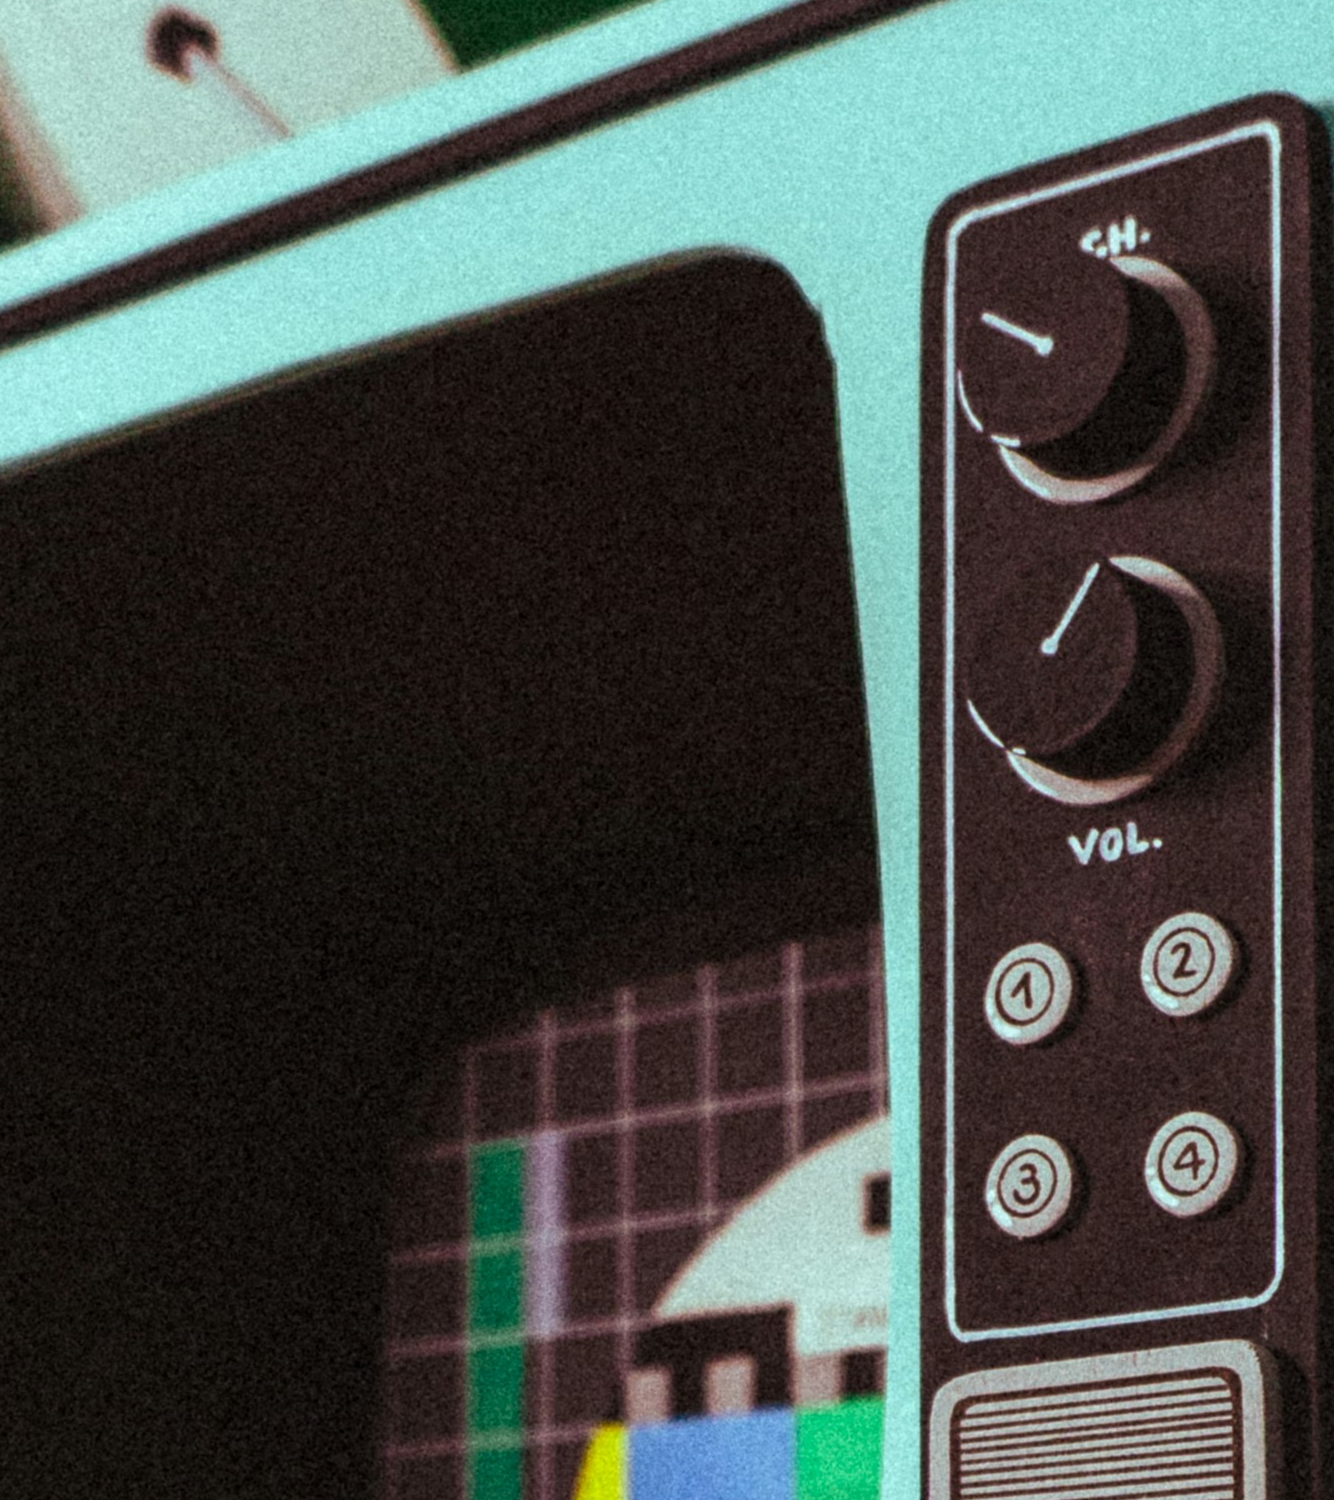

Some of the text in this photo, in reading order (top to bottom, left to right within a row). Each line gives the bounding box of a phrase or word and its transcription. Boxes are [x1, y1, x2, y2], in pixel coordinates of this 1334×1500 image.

[1067, 821, 1162, 865] VOL.
[1010, 941, 1199, 1010] 1 2
[1012, 1140, 1206, 1206] 3 4
